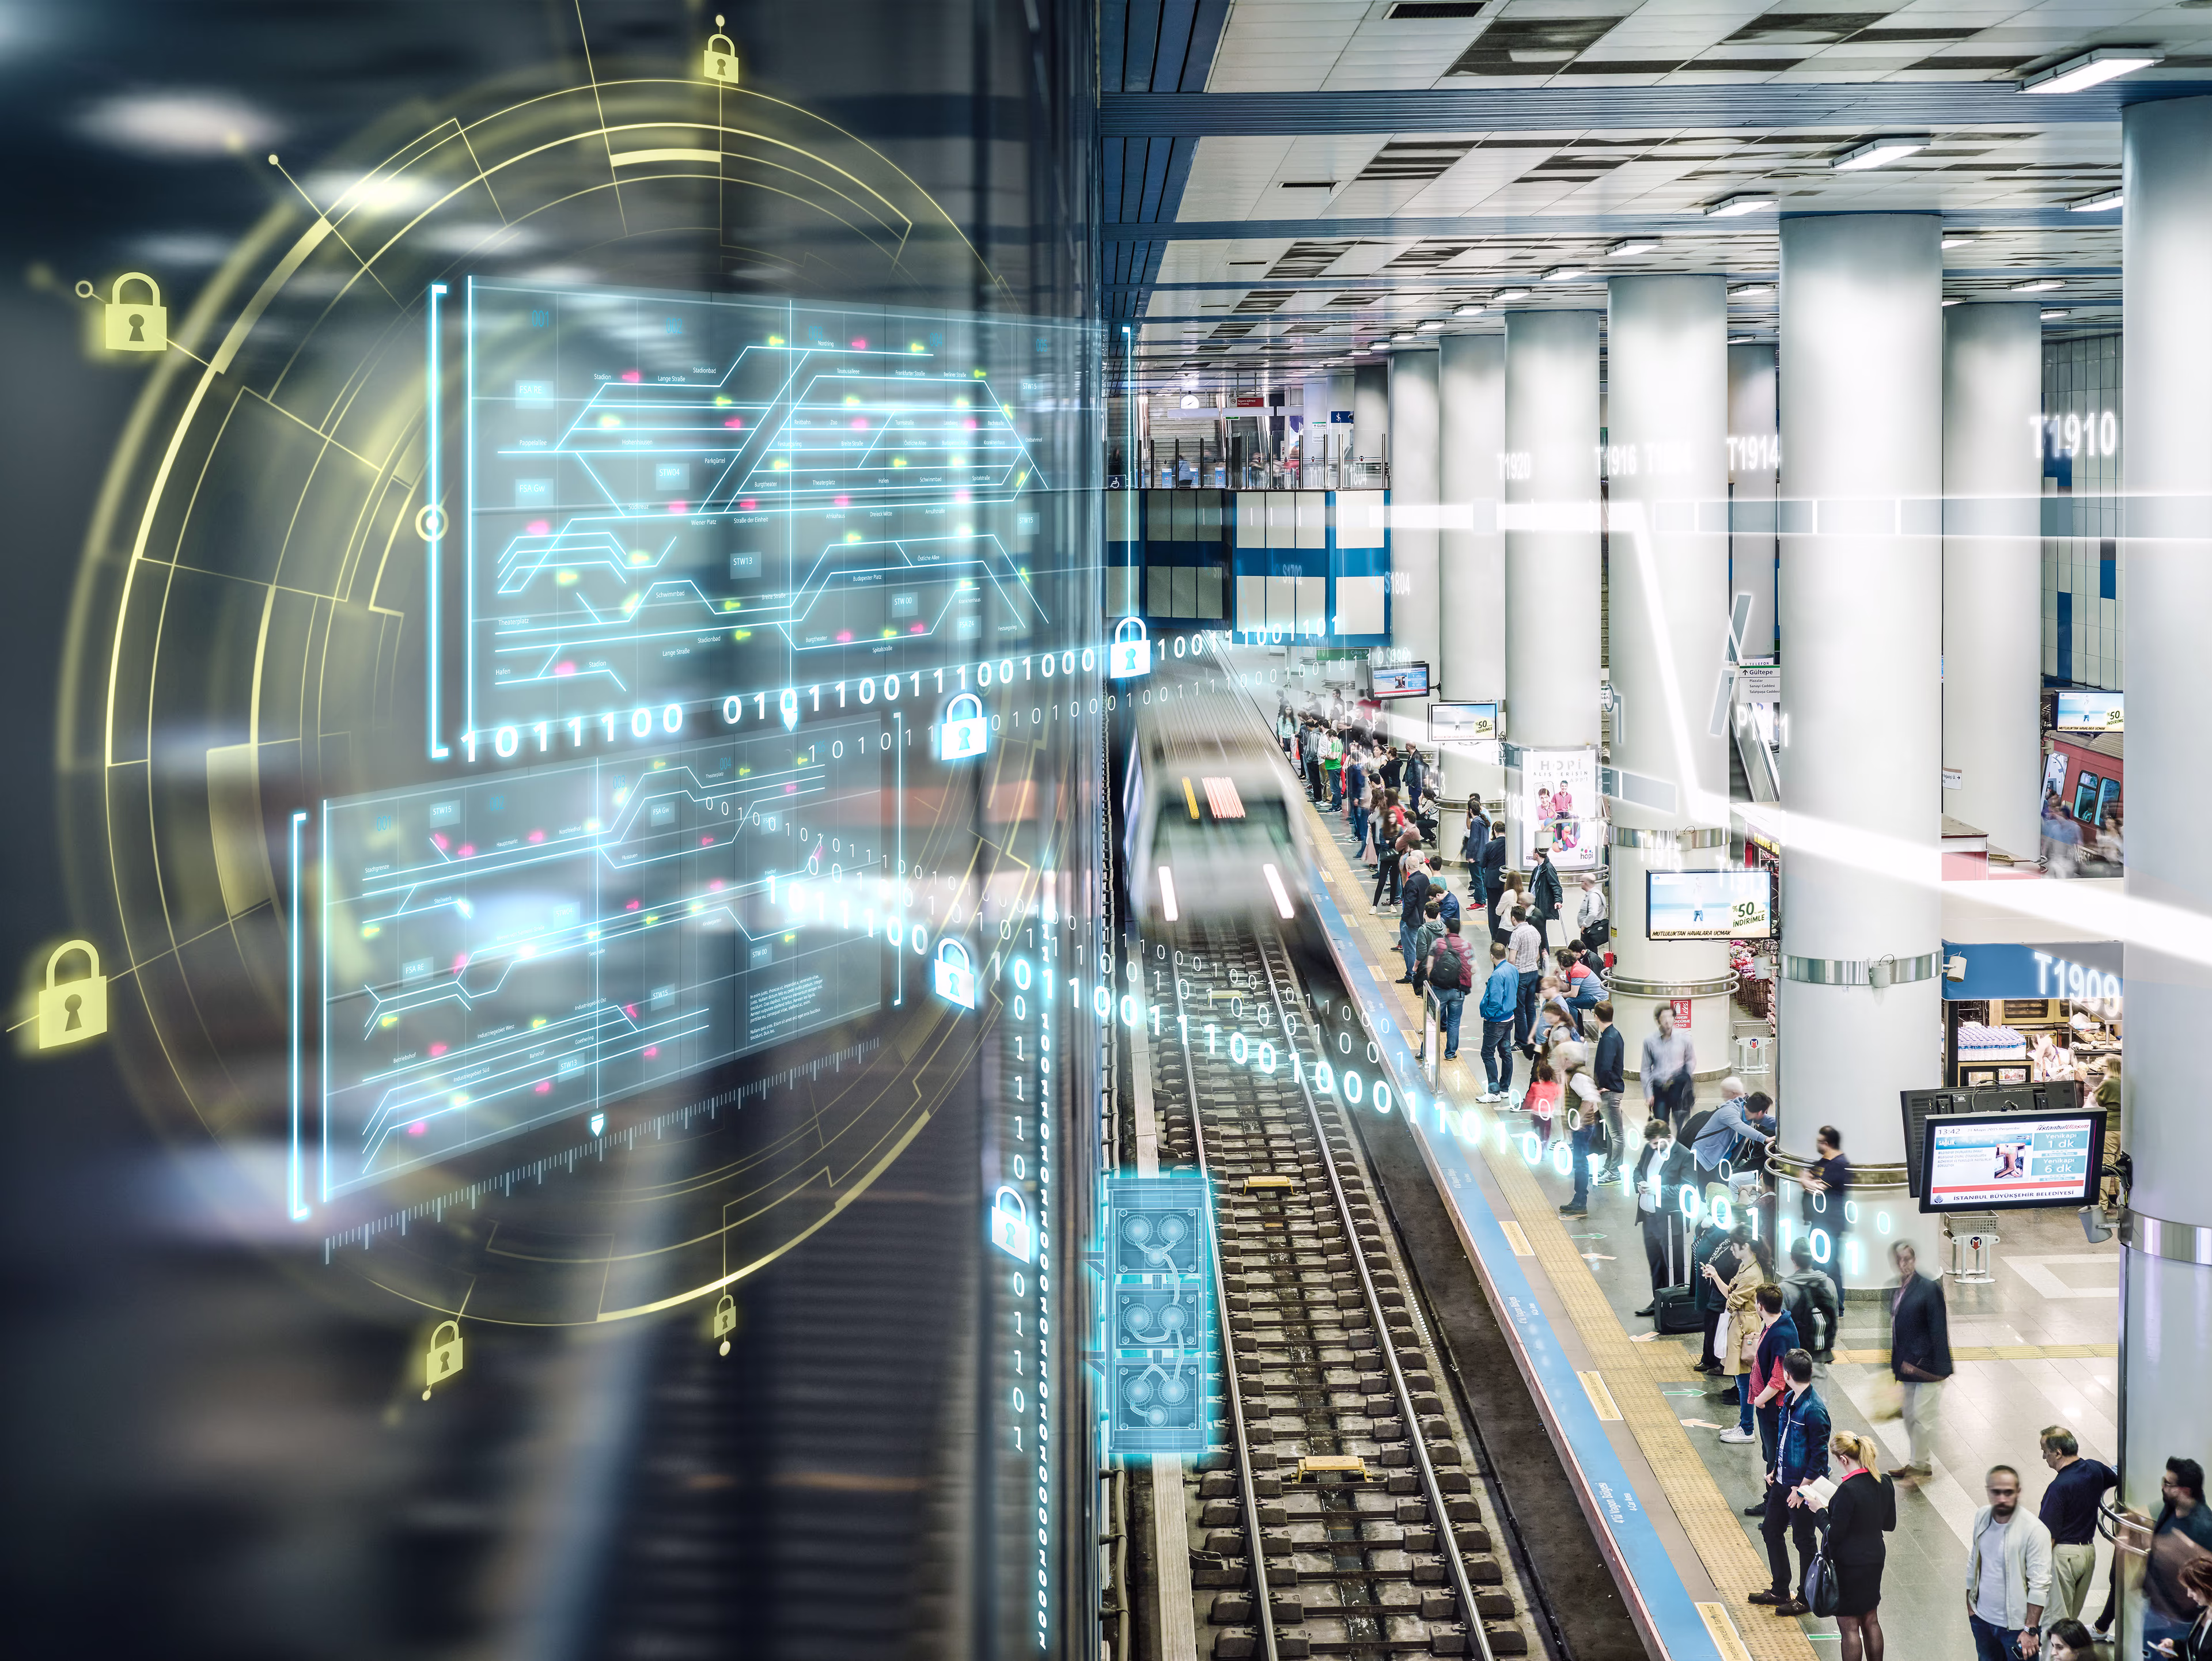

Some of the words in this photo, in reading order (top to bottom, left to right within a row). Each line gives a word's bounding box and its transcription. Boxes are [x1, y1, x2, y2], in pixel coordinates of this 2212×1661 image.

[1580, 852, 1593, 860] hopi
[1732, 913, 1765, 928] İNDİRİMLE
[1938, 1139, 1956, 1147] SAĞLIK
[2048, 1140, 2054, 1148] 1
[2058, 1139, 2074, 1148] dk
[2044, 1165, 2053, 1173] 6
[2056, 1164, 2072, 1173] dk
[1594, 1482, 1613, 1499] Bölgesi
[1623, 1493, 1633, 1501] Area
[1606, 1499, 1621, 1514] Vagon
